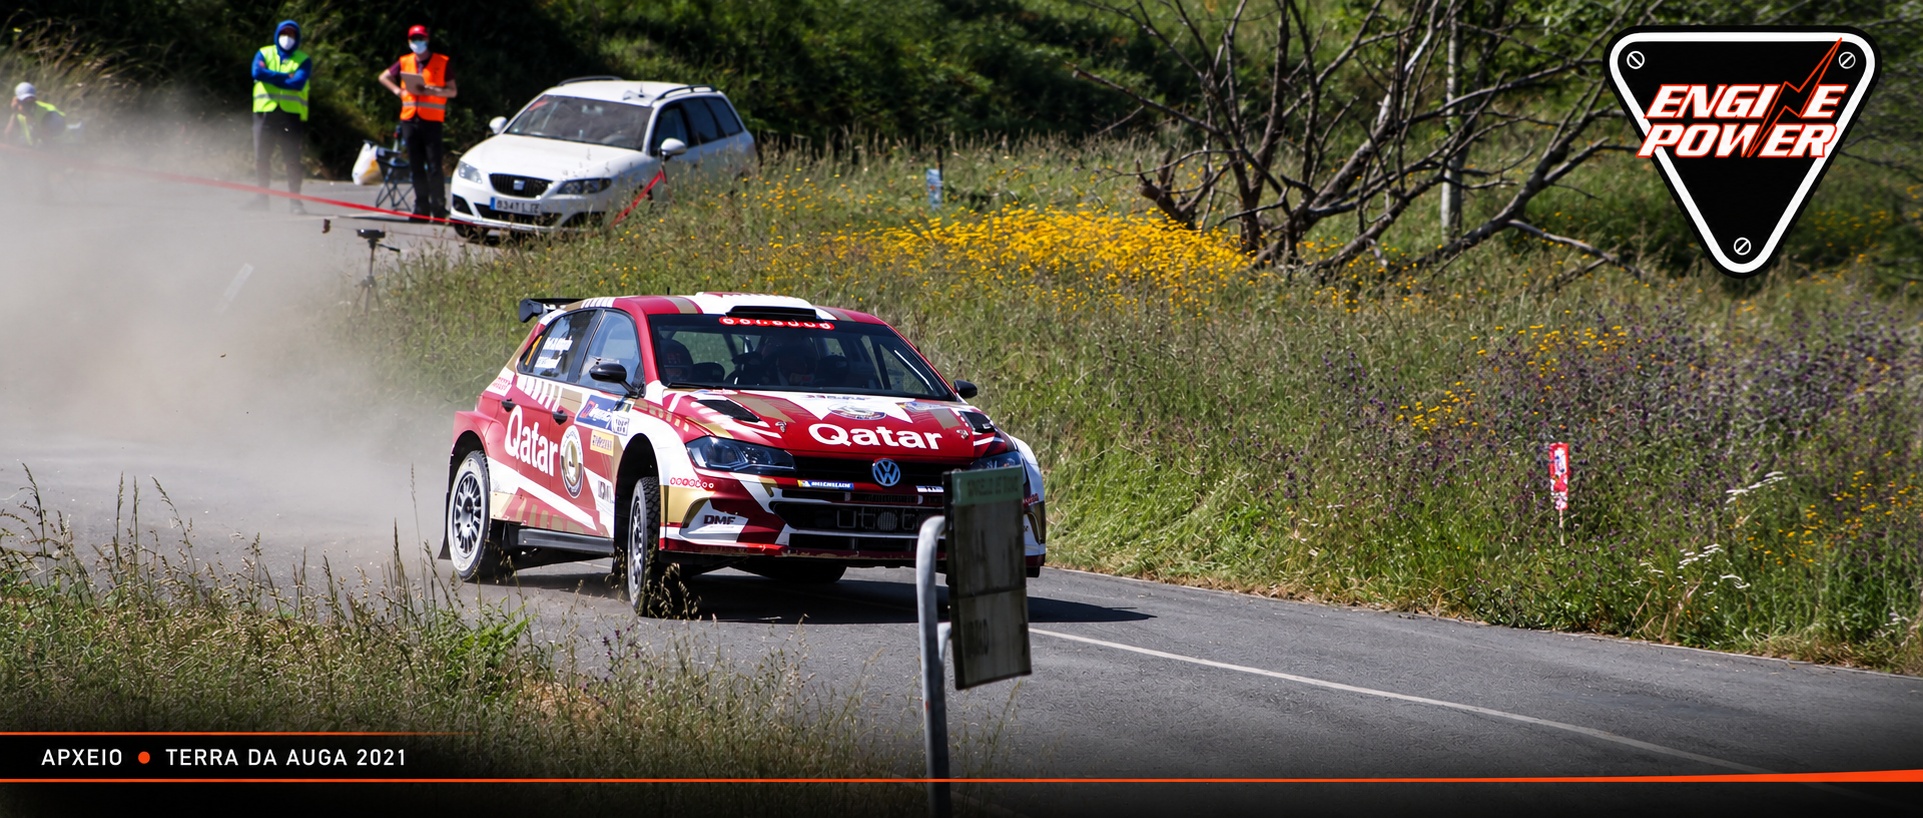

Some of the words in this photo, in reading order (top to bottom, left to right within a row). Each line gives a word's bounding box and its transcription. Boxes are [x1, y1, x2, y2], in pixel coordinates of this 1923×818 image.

[504, 404, 559, 477] Qatar
[808, 423, 942, 449] Qatar
[703, 514, 737, 525] DMF
